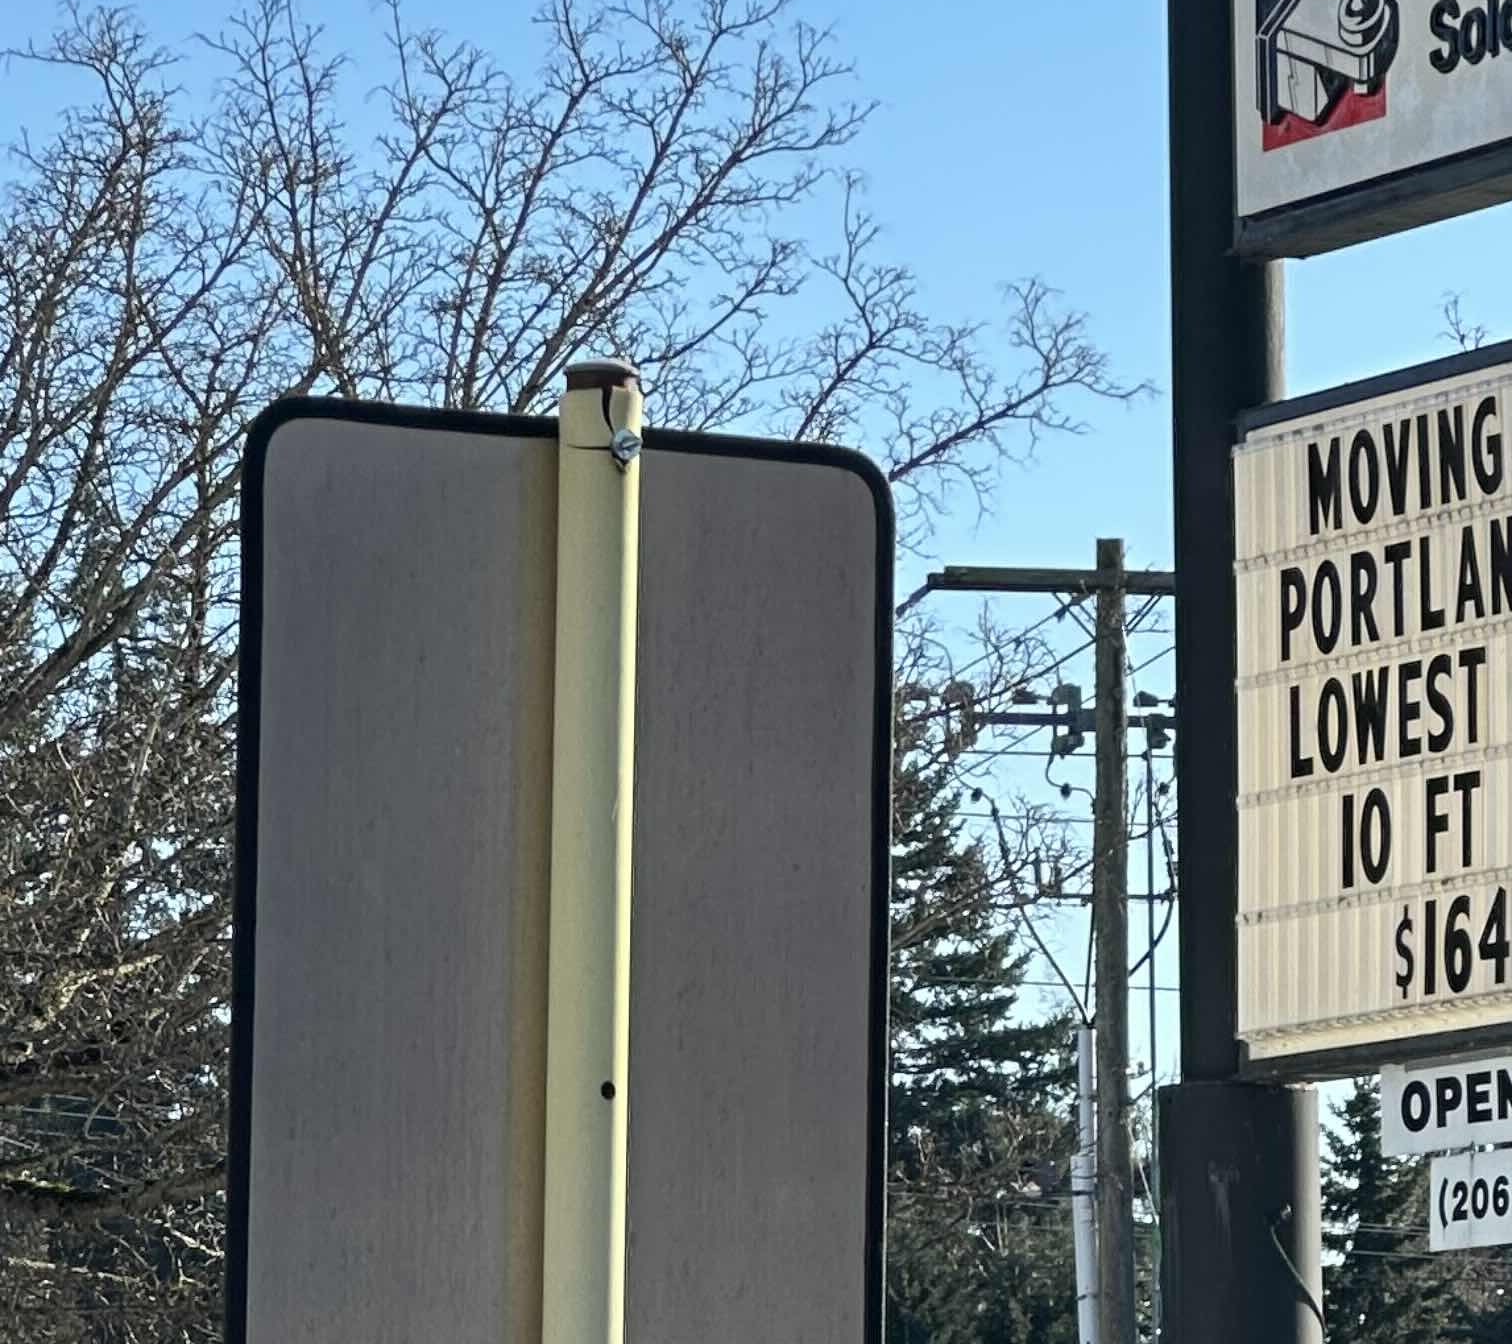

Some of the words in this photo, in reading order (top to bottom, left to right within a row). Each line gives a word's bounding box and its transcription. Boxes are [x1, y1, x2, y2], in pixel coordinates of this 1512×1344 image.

[1307, 396, 1503, 535] MOVING
[1289, 648, 1486, 778] LOWEST
[1341, 788, 1390, 889] 10
[1425, 771, 1481, 874] FT
